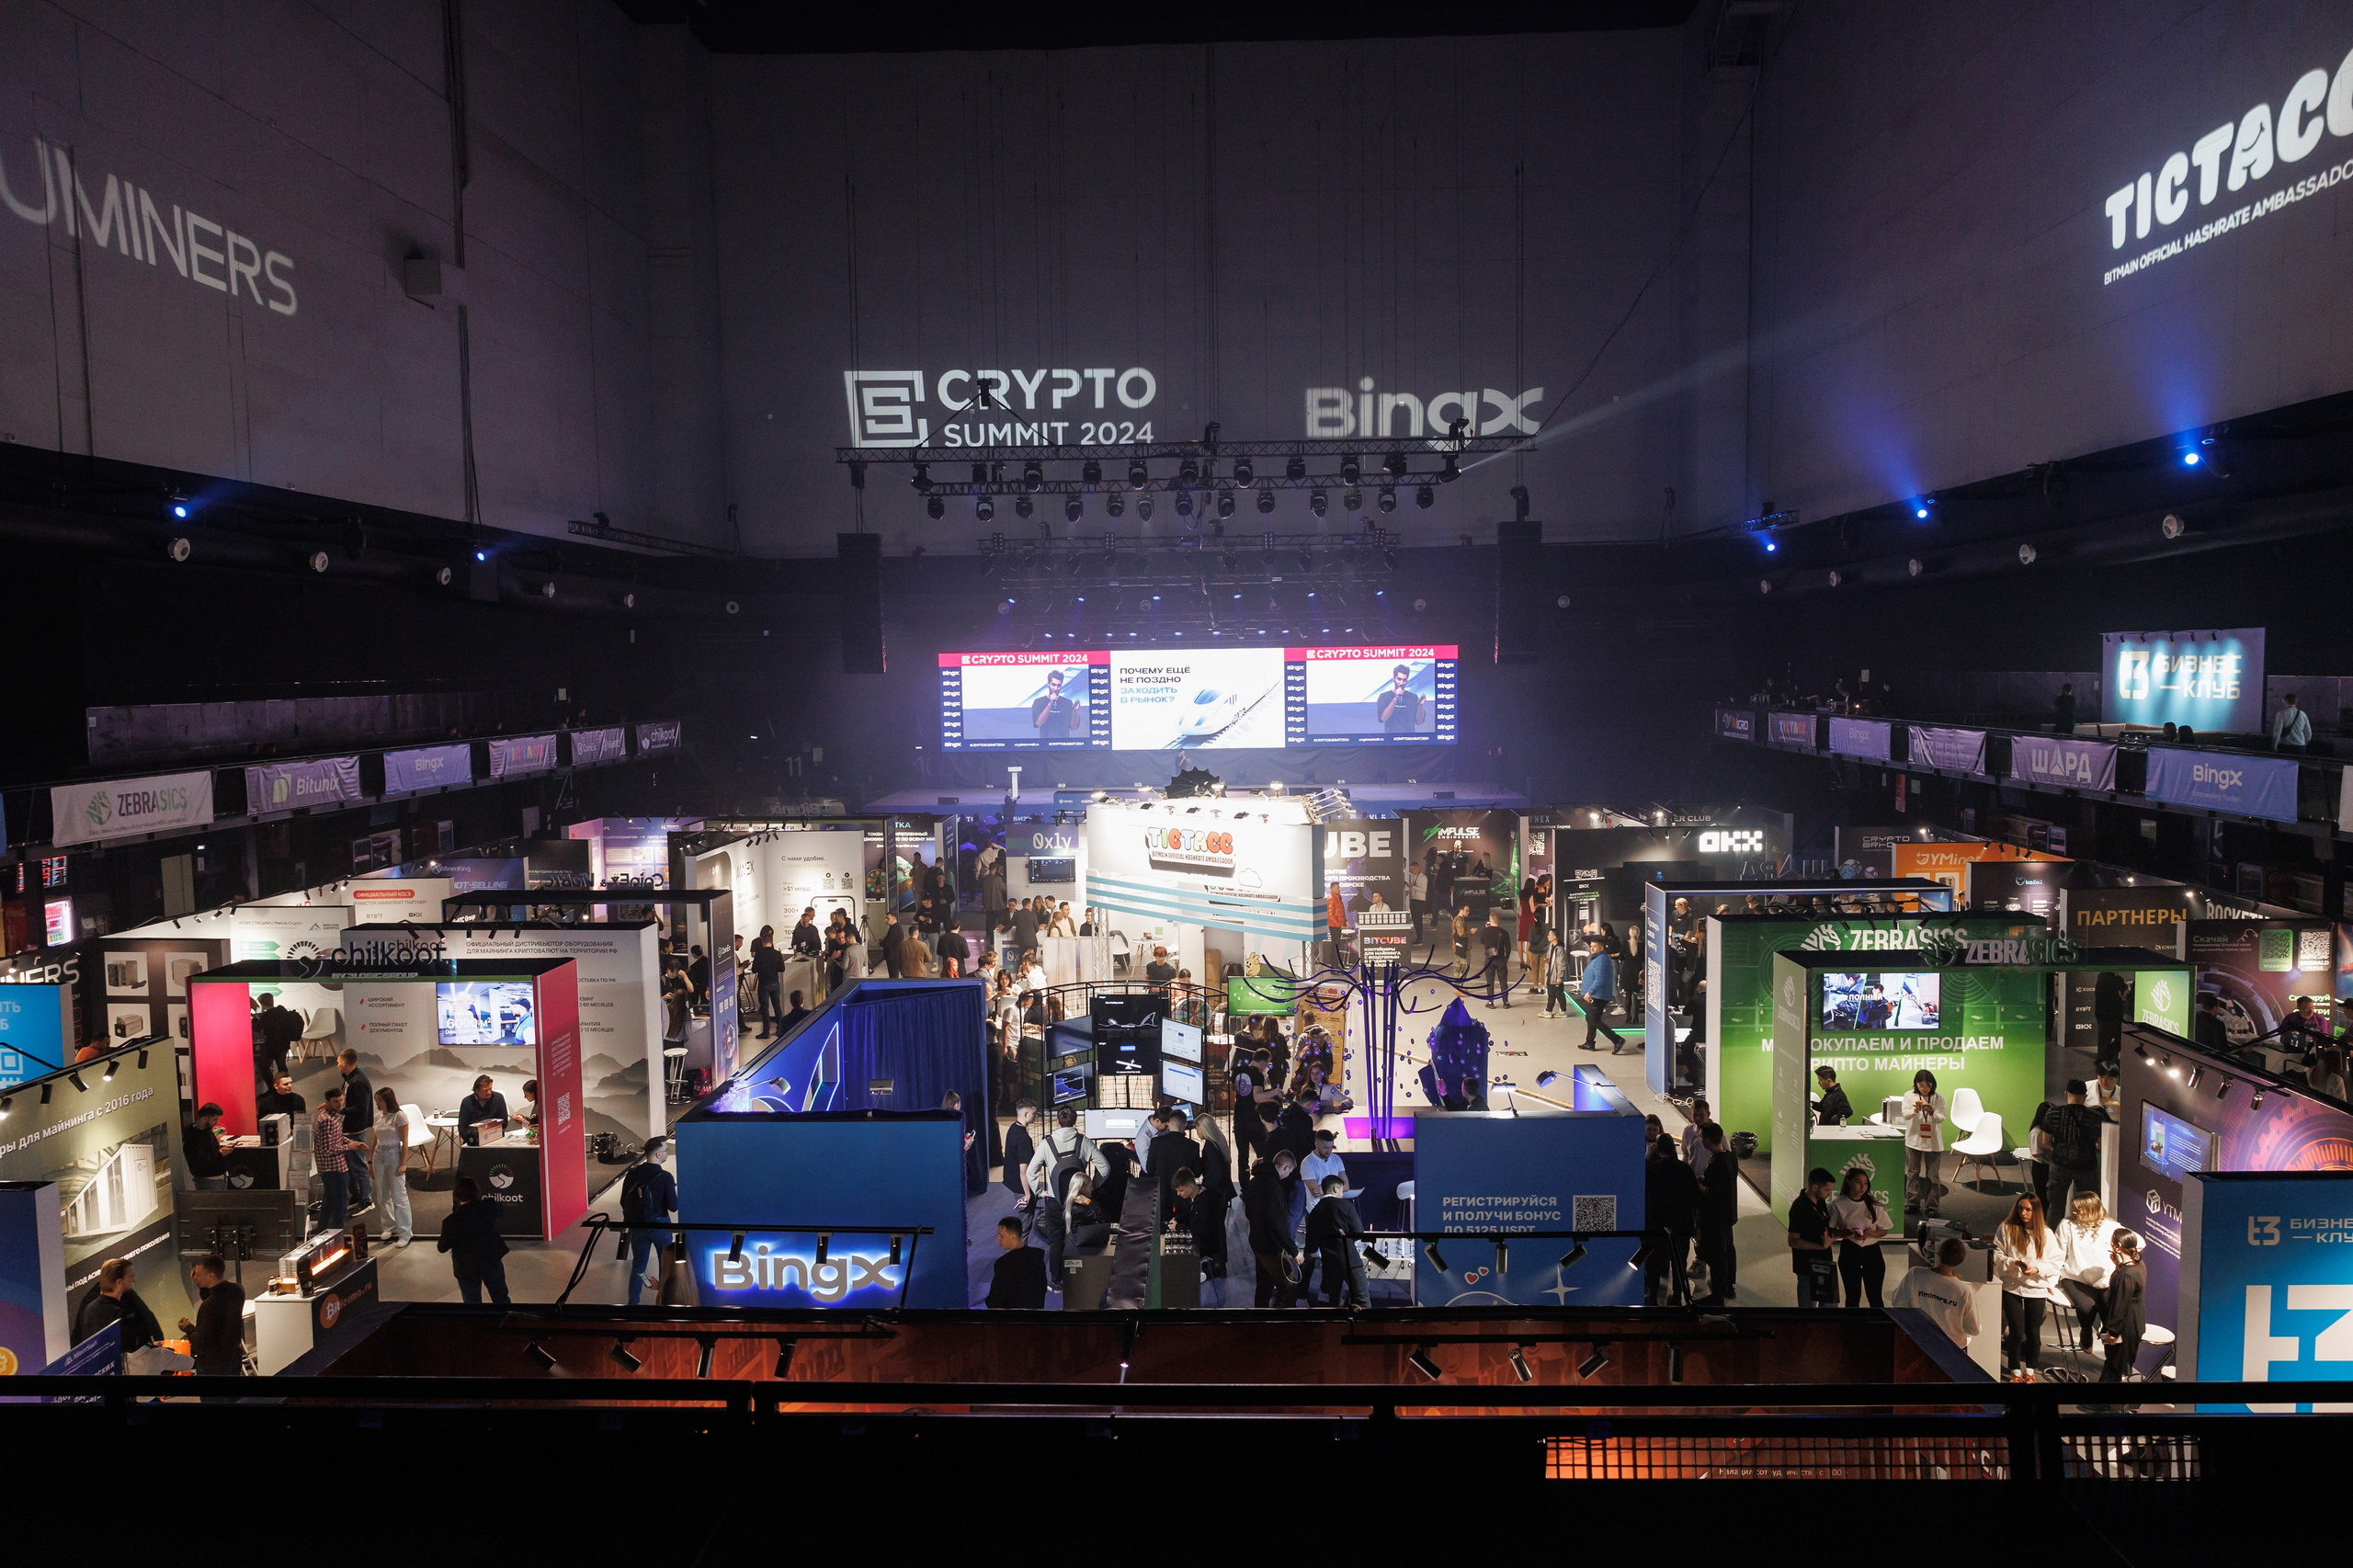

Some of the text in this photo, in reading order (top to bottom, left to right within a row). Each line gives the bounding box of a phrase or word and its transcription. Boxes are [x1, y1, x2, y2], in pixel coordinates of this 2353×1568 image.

[2104, 256, 2139, 286] BITMAIN
[2140, 241, 2183, 269] OFFICIAL
[2184, 204, 2251, 250] HASHRATE
[938, 367, 1156, 411] CRYPTO
[944, 421, 1154, 447] SUMMIT 2024
[971, 653, 1088, 665] CRYPTO SUMMIT 2024
[1316, 648, 1435, 658] CRYPTO SUMMIT 2024
[1120, 665, 1191, 675] ПОЧЕМУ ЕЩЁ
[1136, 676, 1181, 684] ПОЗДНО
[1120, 687, 1178, 695] ЗАХОДИТЬ
[2184, 680, 2241, 699] КЛУБ
[295, 774, 340, 796] Bitunix
[117, 787, 188, 817] ZEBRASICS
[1438, 826, 1480, 836] IMPULSE
[1147, 826, 1233, 855] TICTACC
[1699, 830, 1763, 853] OKX
[802, 855, 826, 864] удобно.
[1152, 850, 1168, 858] BITMAIN
[1185, 854, 1205, 862] HASHRATE
[1205, 856, 1233, 866] AMBASSADOR
[2076, 908, 2187, 926] ПАРТНЕРЫ
[1363, 937, 1407, 945] BITCUBE
[2192, 935, 2229, 944] Скачай
[331, 940, 447, 966] chilkoot
[1965, 937, 2081, 965] ZEBRASICS
[2142, 1008, 2180, 1035] ZEBRASICS
[1900, 1038, 1912, 1051] И
[1917, 1036, 2005, 1052] ПРОДАЕМ
[1874, 1054, 1965, 1071] МАЙНЕРЫ
[18, 1085, 153, 1151] для майнинга с 2016 года
[1442, 1194, 1558, 1207] РЕГИСТРИРУЙСЯ
[1442, 1210, 1562, 1221] И ПОЛУЧИ БОНУС
[1444, 1225, 1537, 1233] ДО 5125 USDT
[74, 1232, 170, 1289] ПОД ПОКОЛЕНИЯ
